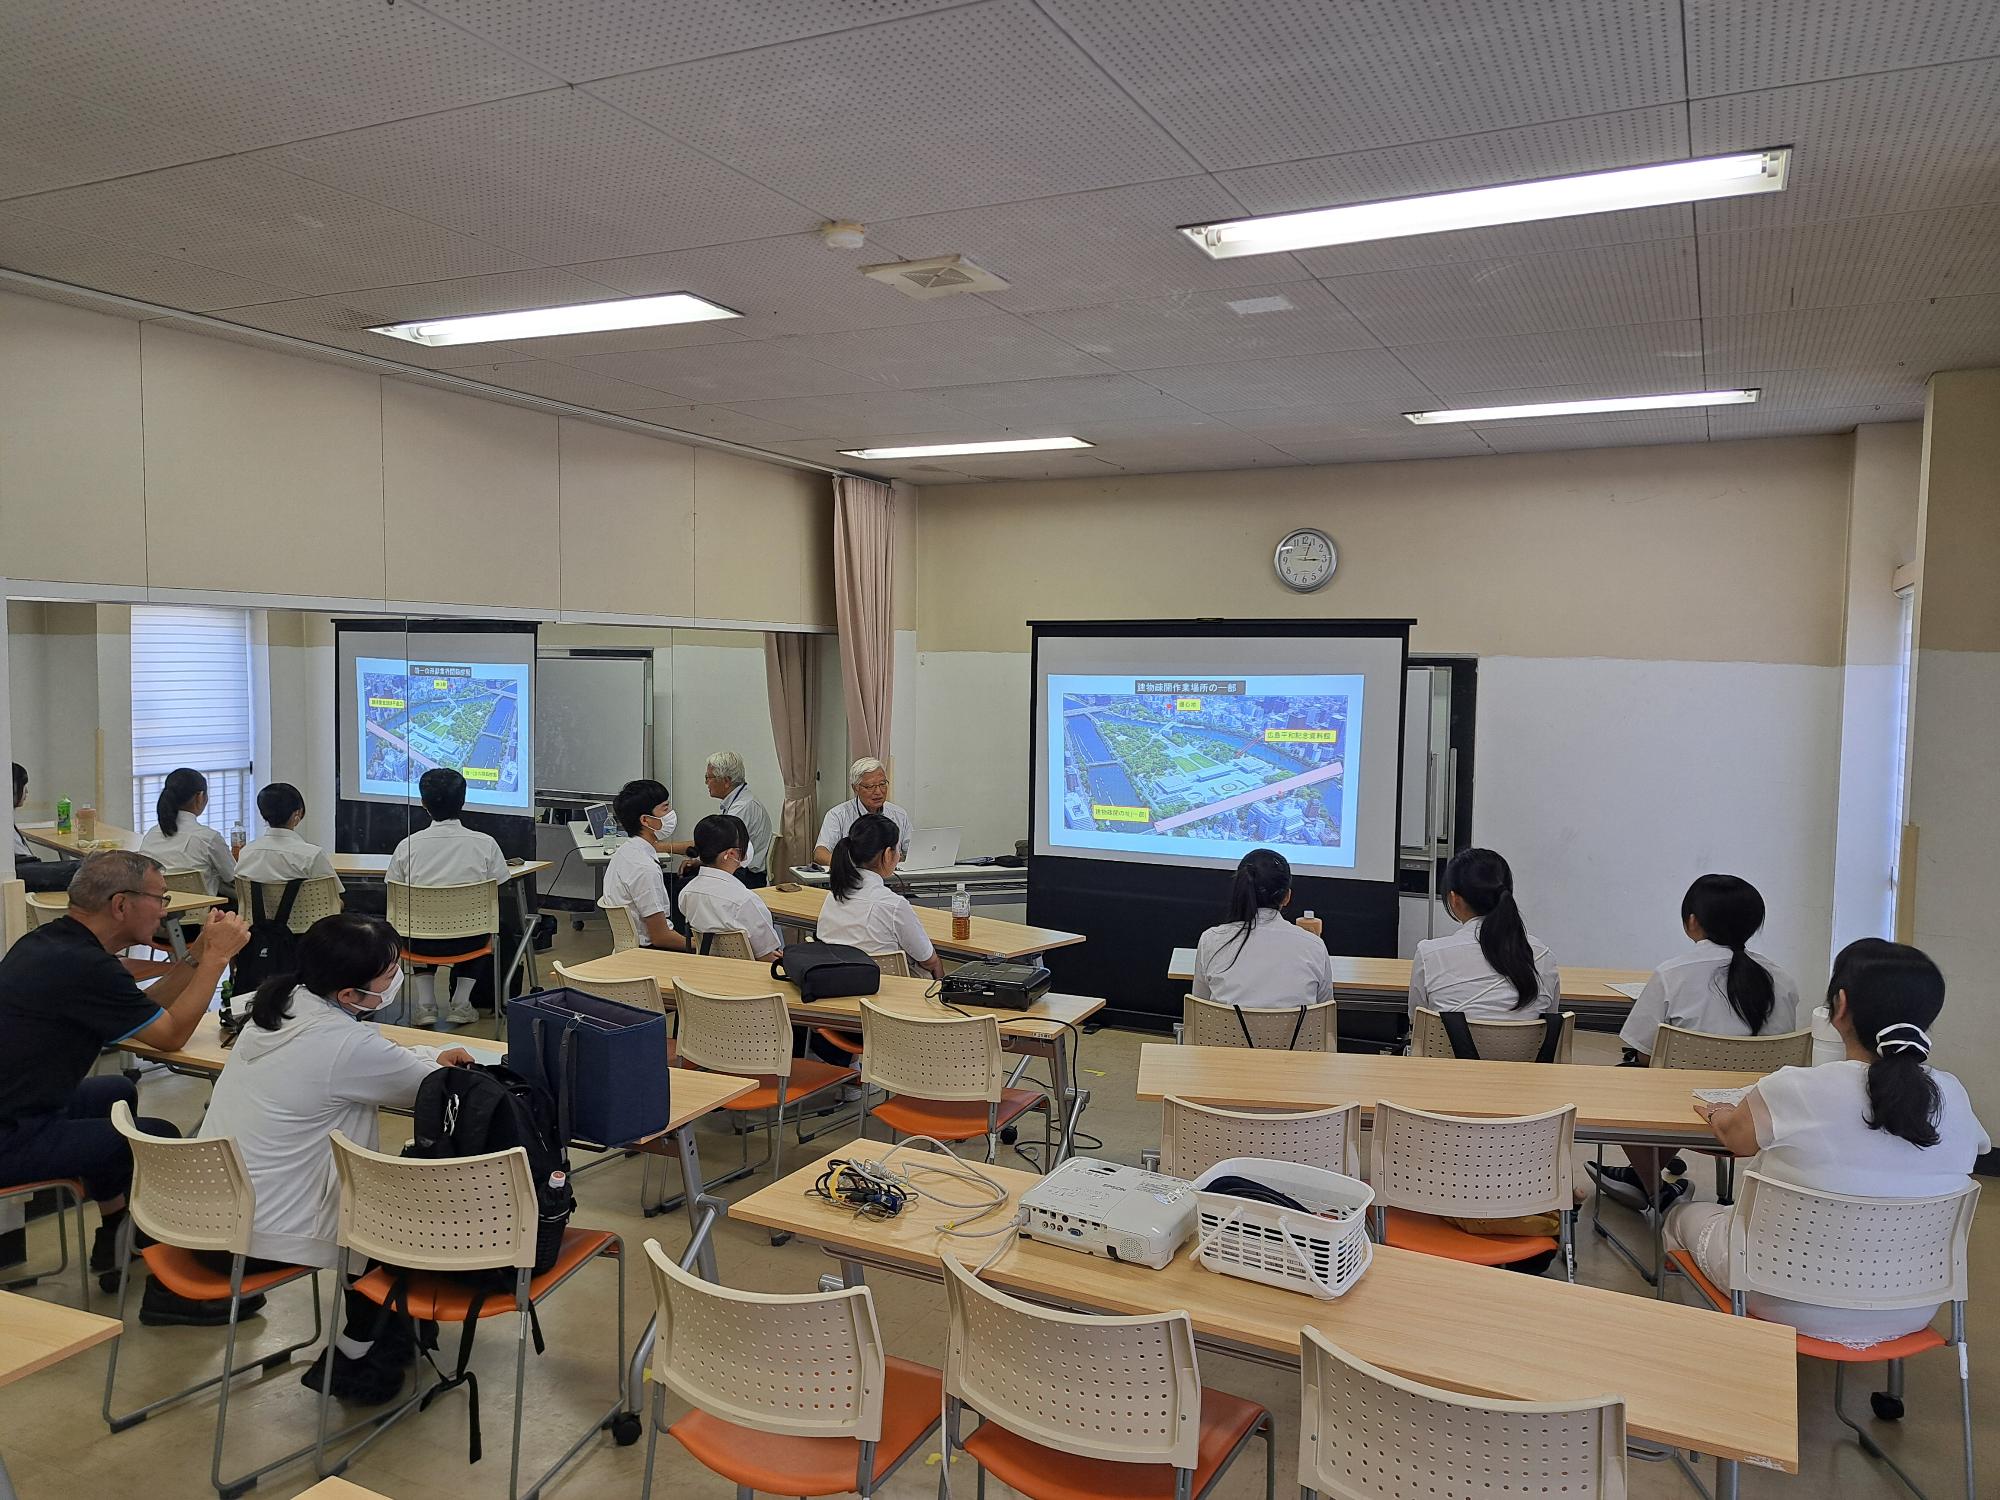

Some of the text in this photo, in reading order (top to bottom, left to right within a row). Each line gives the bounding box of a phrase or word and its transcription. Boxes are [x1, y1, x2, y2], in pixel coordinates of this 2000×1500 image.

[1137, 682, 1237, 693] 建物疎開作業場所の一部
[1102, 1183, 1127, 1192] EPSON
